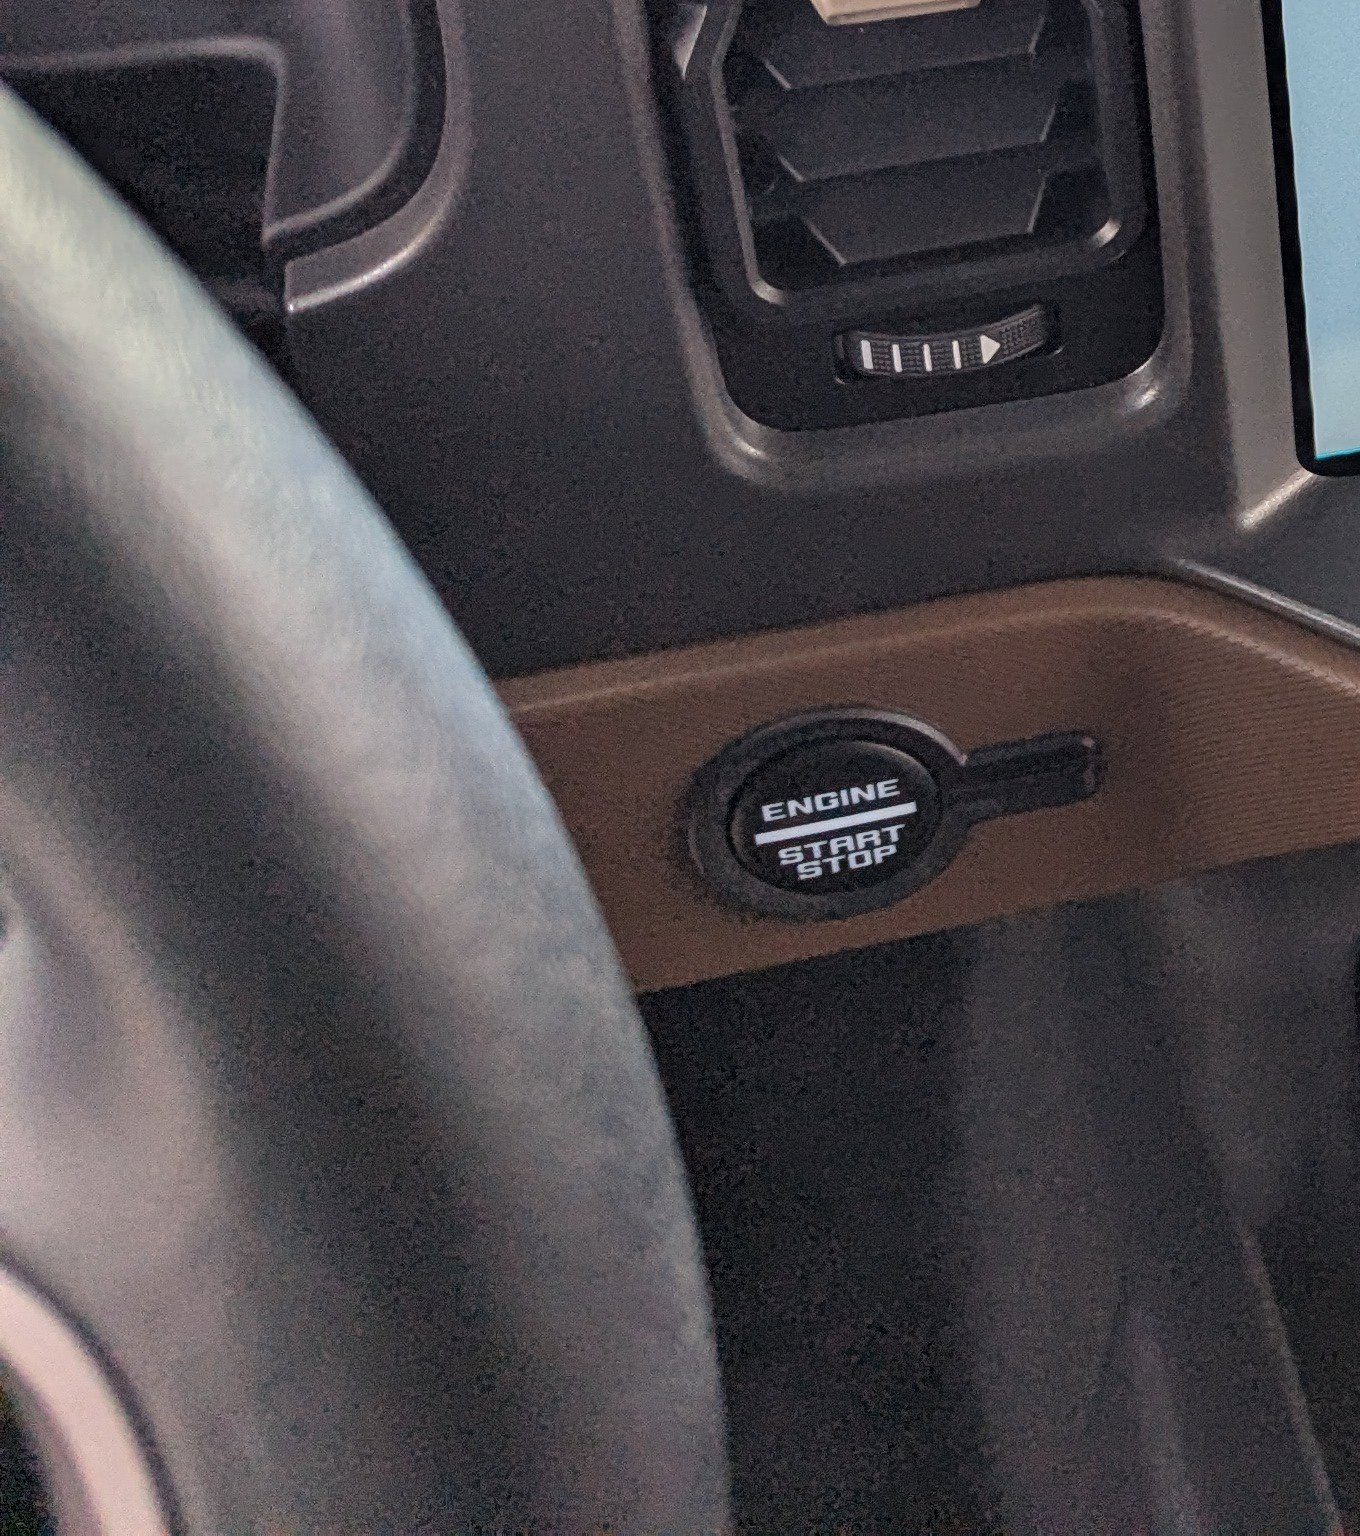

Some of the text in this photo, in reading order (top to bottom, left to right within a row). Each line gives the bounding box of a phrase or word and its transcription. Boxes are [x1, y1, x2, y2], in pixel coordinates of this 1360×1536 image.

[761, 778, 901, 822] ENGINE
[778, 824, 906, 865] START
[797, 844, 897, 880] STOP
